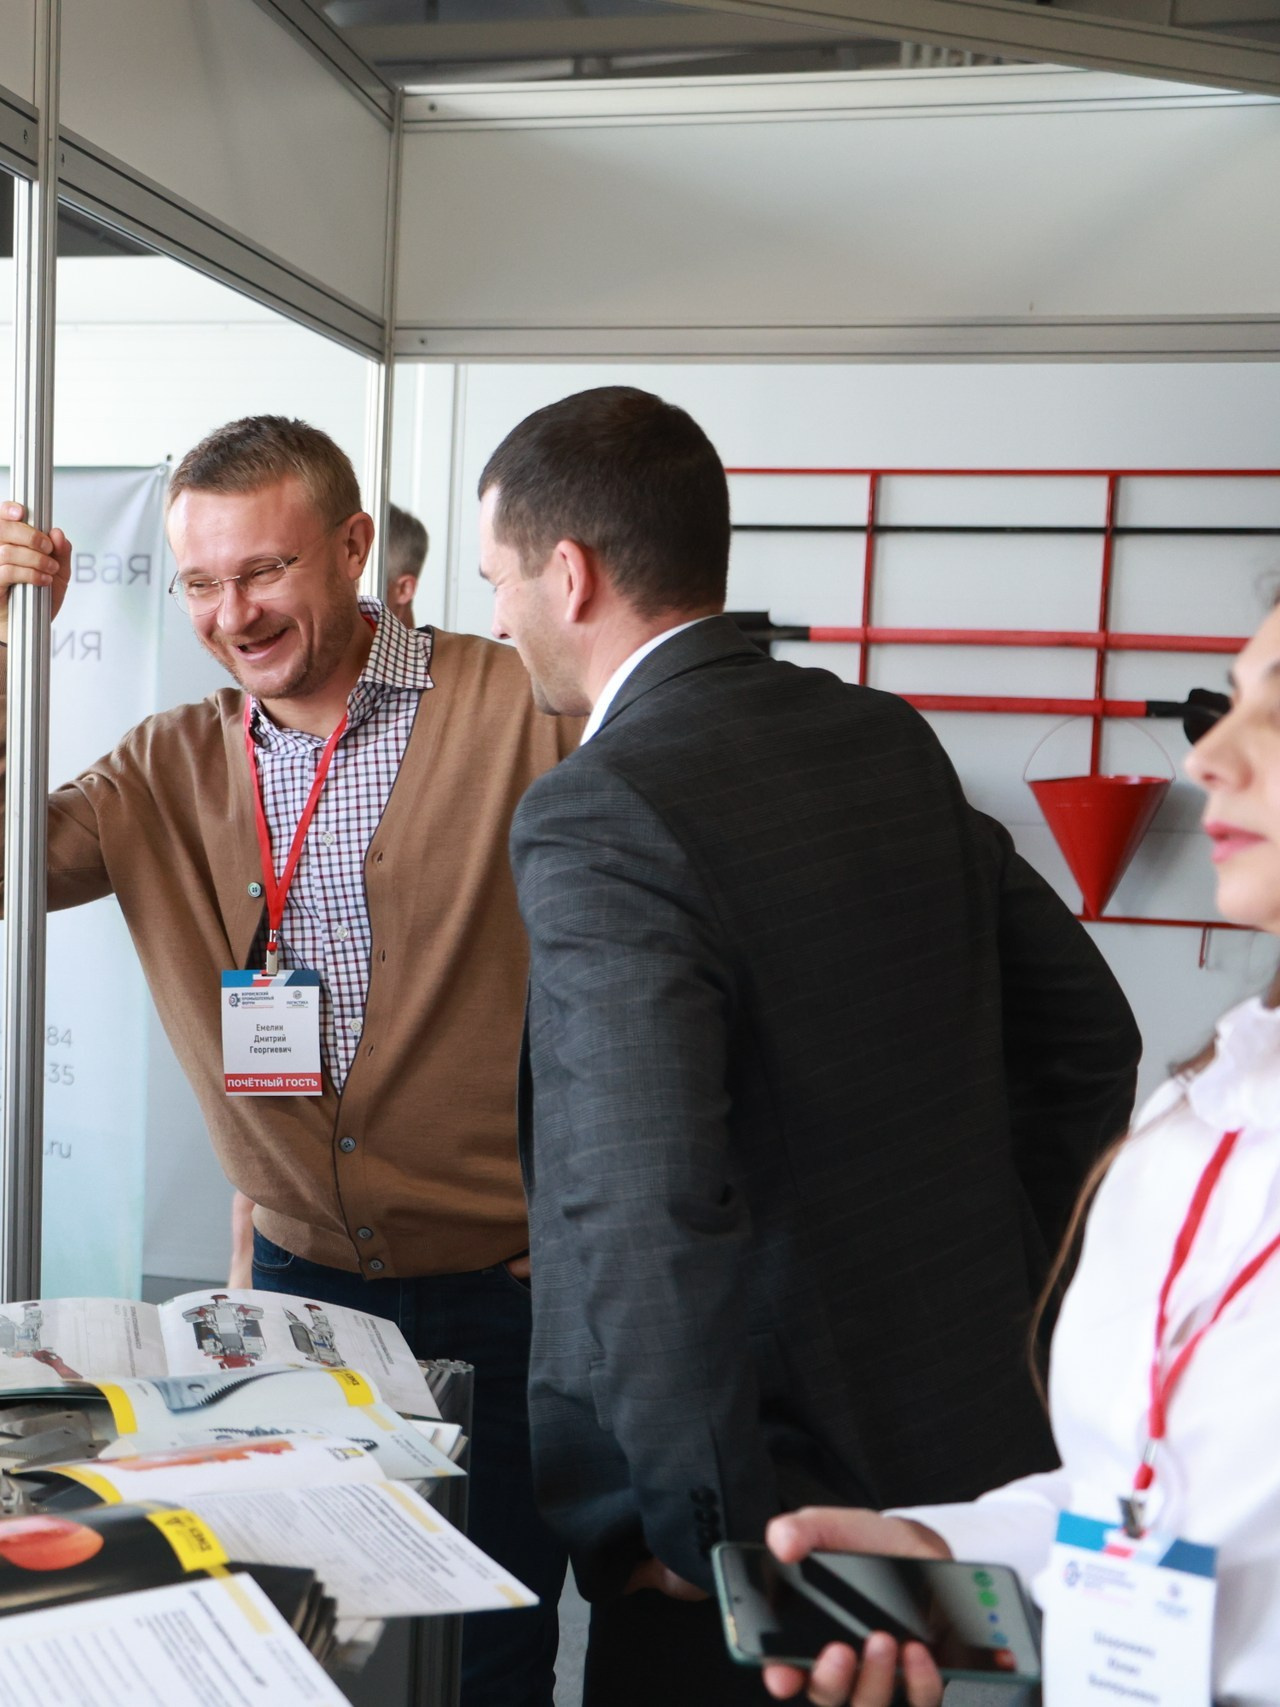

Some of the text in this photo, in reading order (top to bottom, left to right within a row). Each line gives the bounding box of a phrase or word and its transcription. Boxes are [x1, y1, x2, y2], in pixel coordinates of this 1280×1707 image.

[256, 1023, 284, 1032] Емелин
[253, 1033, 287, 1044] Дмитрий
[249, 1045, 292, 1055] Георгиевич
[227, 1077, 318, 1088] ПОЧЁТНЫЙ ГОСТЬ
